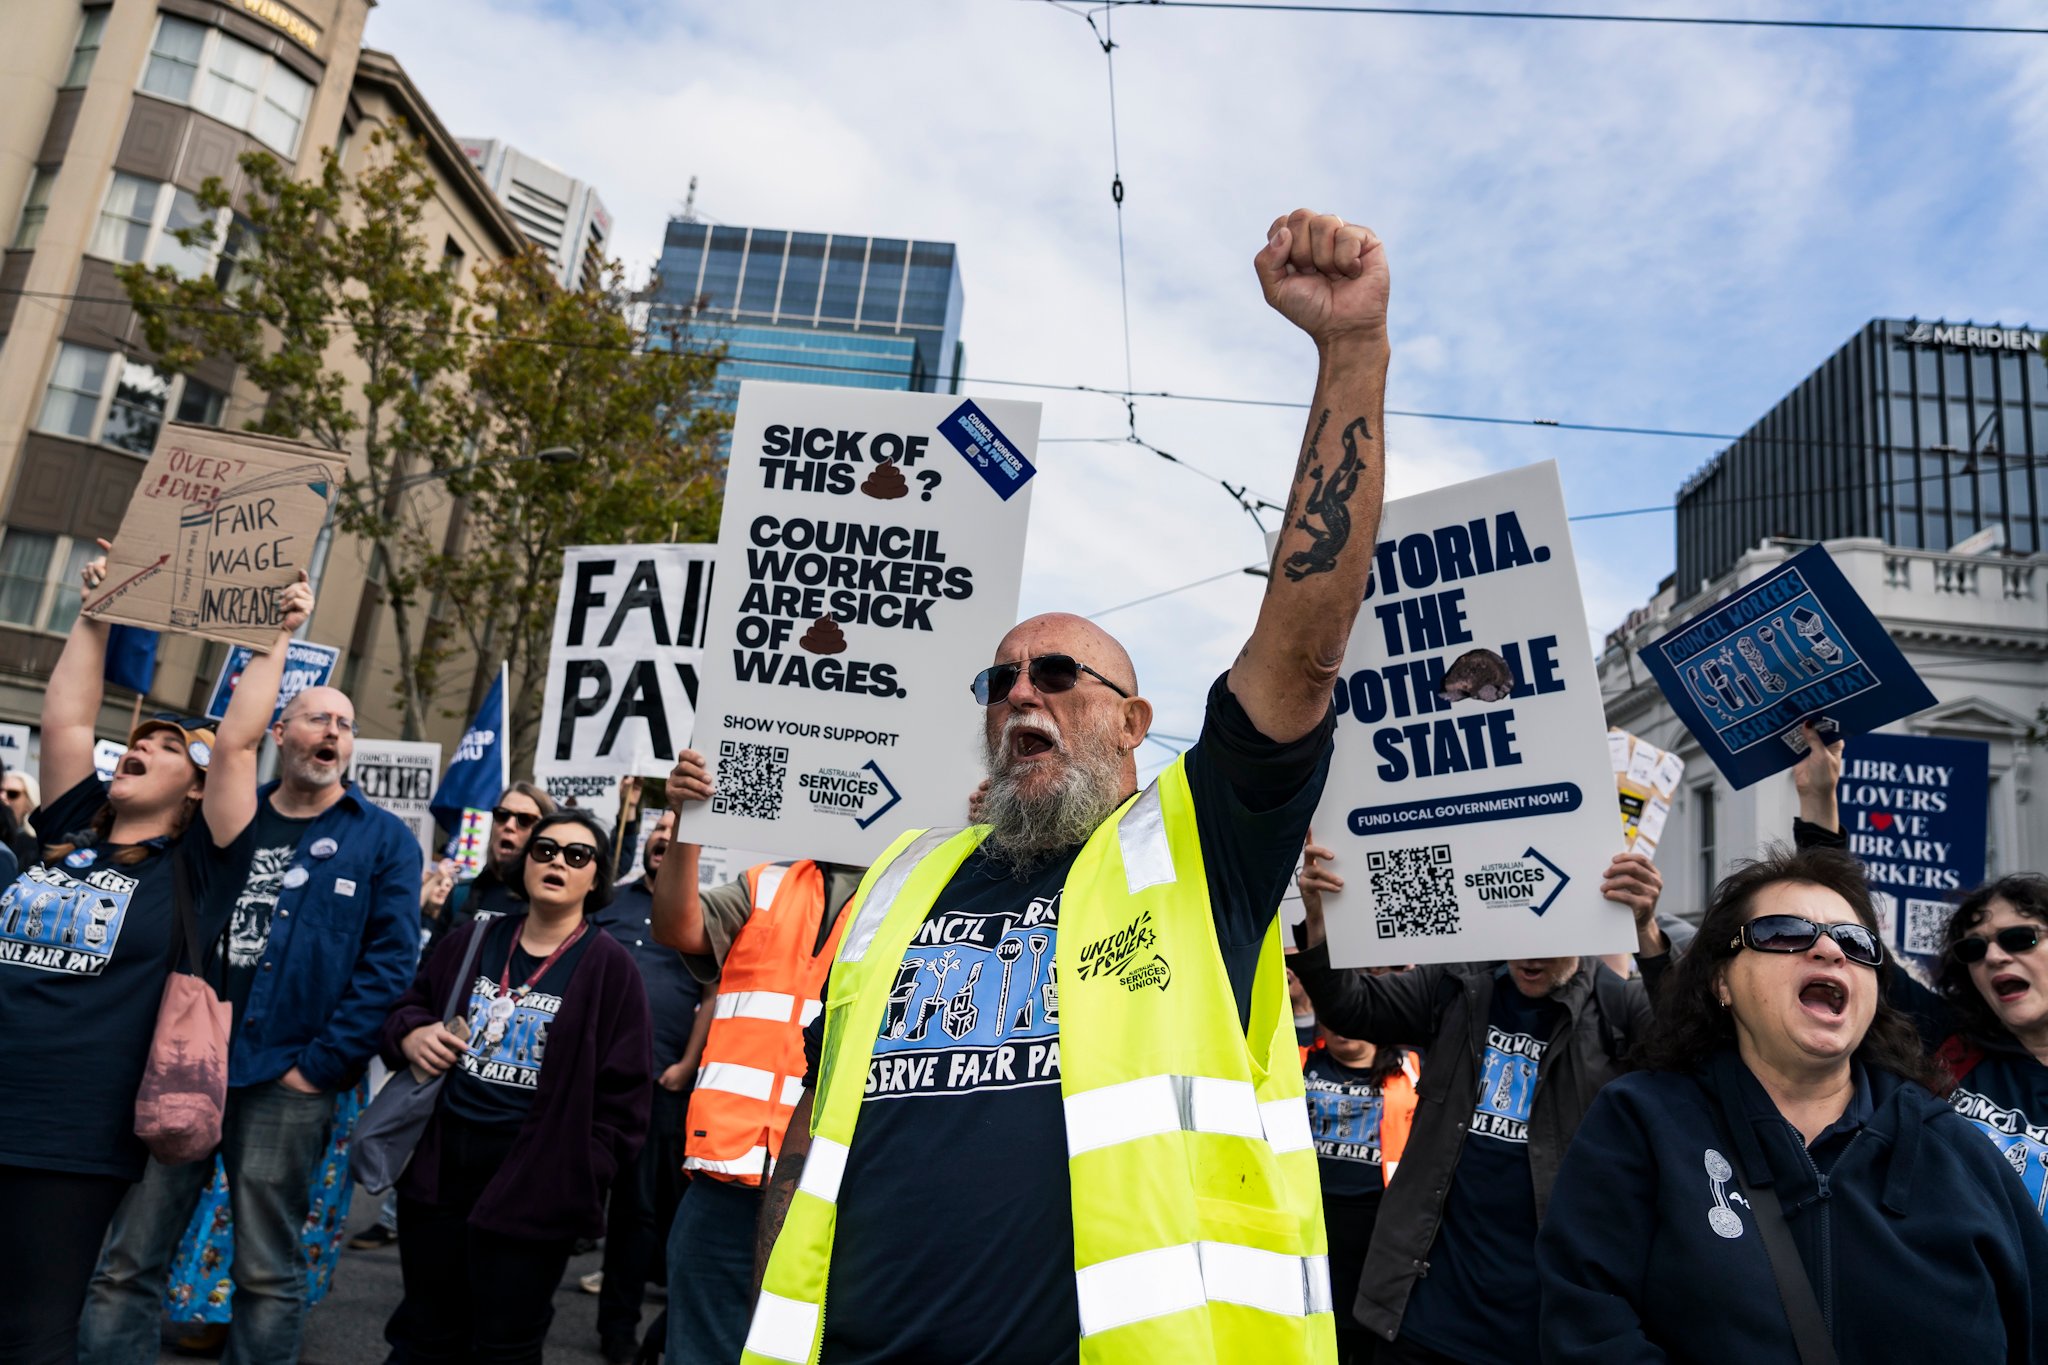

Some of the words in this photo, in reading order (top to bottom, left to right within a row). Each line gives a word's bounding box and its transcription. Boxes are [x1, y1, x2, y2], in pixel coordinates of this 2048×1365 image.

[244, 0, 318, 49] WINDSOR
[1934, 325, 2041, 350] MERIDIEN
[762, 424, 867, 462] SICK
[870, 433, 929, 466] OF
[958, 415, 988, 447] DESERVE
[983, 444, 992, 453] A
[988, 449, 1005, 463] PAY
[968, 413, 994, 441] COUNCIL
[993, 438, 1023, 471] WORKERS
[170, 451, 231, 482] OVER
[759, 457, 856, 495] THIS
[215, 497, 278, 536] FAIR
[750, 515, 946, 563] COUNCIL
[209, 536, 294, 576] WAGE
[747, 548, 973, 600] WORKERS
[566, 559, 715, 648] FAI
[738, 583, 825, 619] ARE
[829, 590, 937, 631] SICK
[1668, 617, 1728, 662] COUNCIL
[1727, 572, 1803, 628] WORKERS
[736, 615, 793, 650] OF
[1375, 588, 1473, 657] THE
[286, 646, 333, 667] ORKERS
[733, 649, 907, 699] WAGES.
[1724, 702, 1794, 748] DESERVE
[1791, 688, 1828, 715] FAIR
[1834, 665, 1869, 696] PAY
[723, 715, 774, 732] SHOW
[776, 720, 820, 738] YOUR
[823, 726, 899, 747] SUPPORT
[1372, 708, 1523, 783] STATE
[546, 775, 616, 786] WORKERS
[799, 774, 878, 795] SERVICES
[818, 768, 861, 778] AUSTRALIAN
[1839, 758, 1954, 787] LIBRARY
[573, 786, 605, 797] SICK
[809, 790, 864, 809] UNION
[1841, 784, 1948, 813] LOVERS
[1358, 814, 1392, 827] FUND
[1393, 811, 1433, 823] LOCAL
[1435, 796, 1525, 818] GOVERNMENT
[1528, 791, 1570, 807] NOW!
[1464, 868, 1545, 887] SERVICES
[1481, 862, 1524, 872] AUSTRALIAN
[1478, 884, 1534, 901] UNION
[998, 943, 1020, 955] STOP
[1080, 915, 1140, 962] UNION
[1092, 927, 1149, 978] POWER
[24, 946, 65, 968] FAIR
[65, 951, 105, 972] PAY
[1120, 966, 1166, 985] SERVICES
[1128, 976, 1161, 992] UNION
[1484, 1029, 1512, 1053] CIL
[481, 1061, 518, 1082] FAIR
[864, 1056, 939, 1094] SERVE
[947, 1046, 1016, 1087] FAIR
[1490, 1116, 1529, 1139] FAIR
[1337, 1143, 1369, 1160] FAIR
